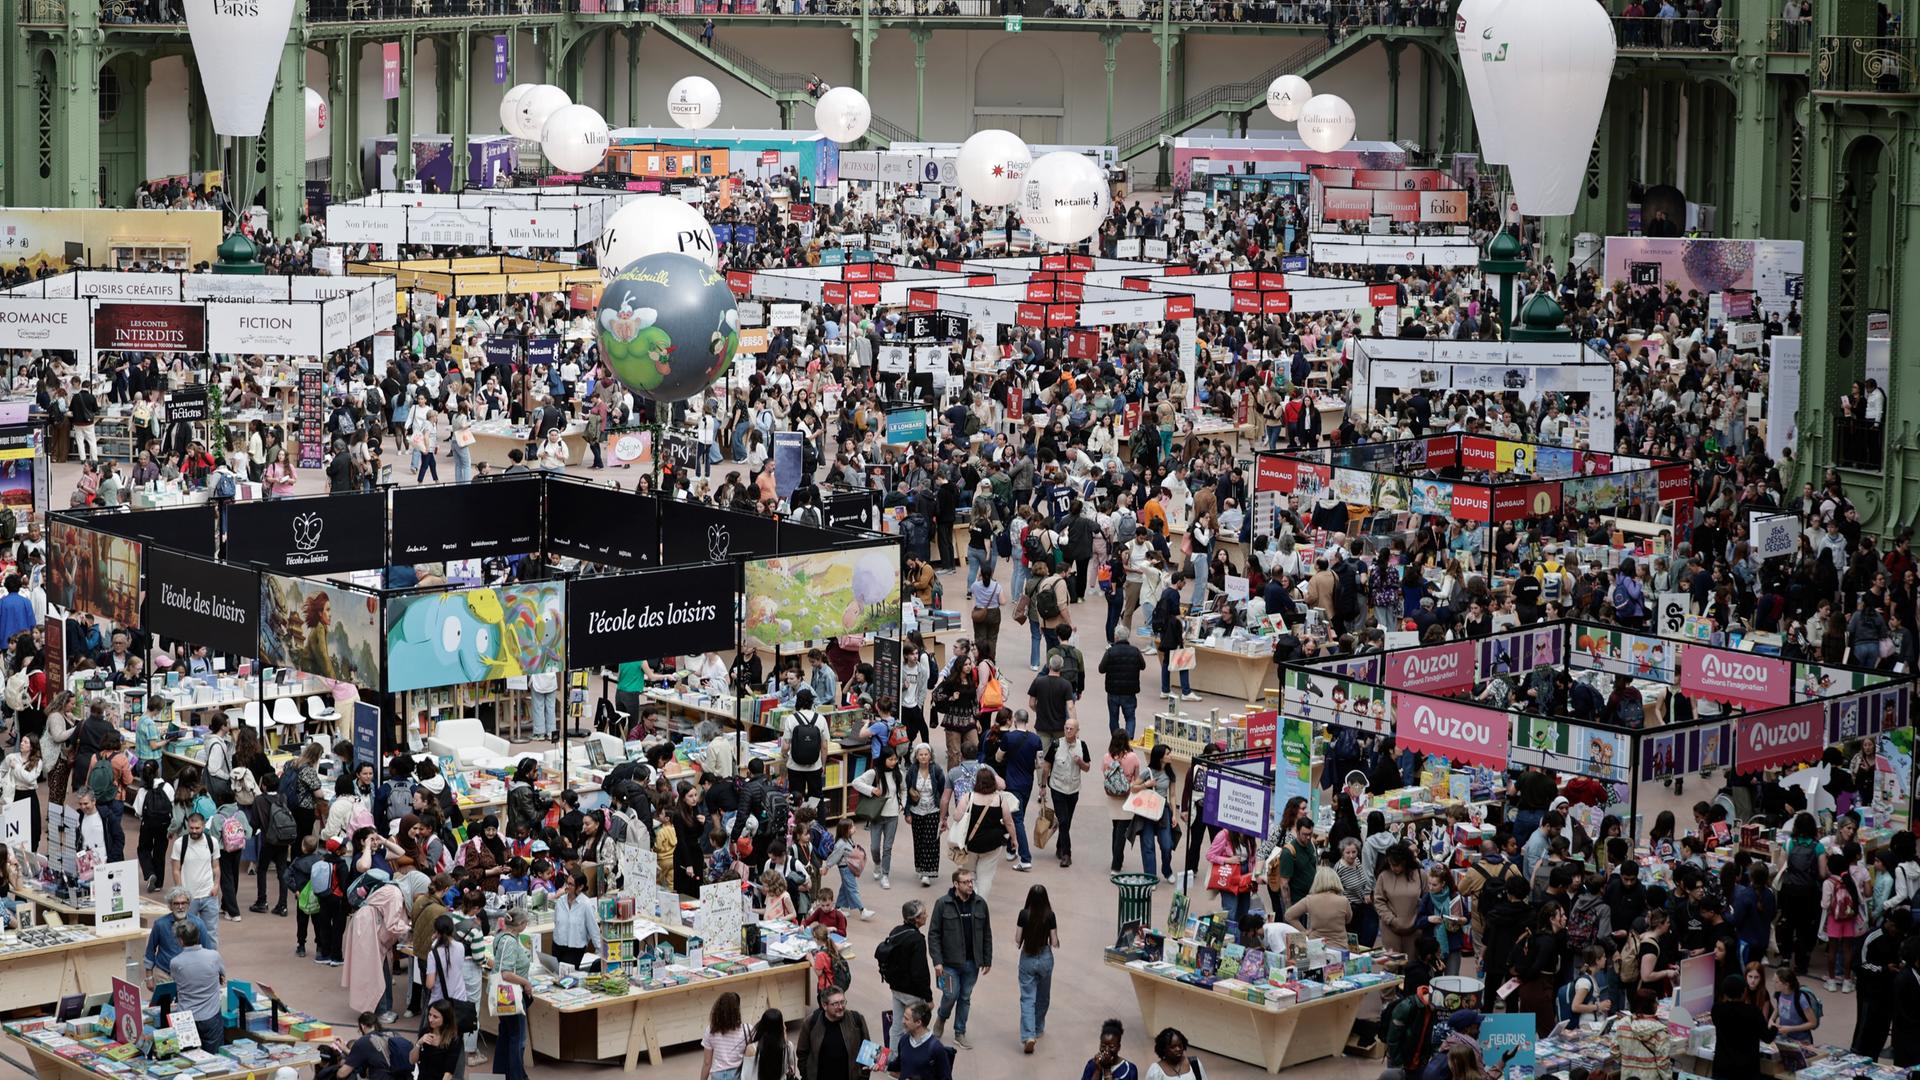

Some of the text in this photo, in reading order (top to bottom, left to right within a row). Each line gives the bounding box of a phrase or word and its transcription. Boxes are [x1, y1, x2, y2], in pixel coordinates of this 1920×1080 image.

[1054, 197, 1091, 208] Métailié
[1328, 199, 1369, 211] Gallimard
[1430, 199, 1457, 215] folio
[508, 228, 560, 239] Albin Michel
[84, 284, 123, 295] LOISIRS
[126, 282, 174, 296] CRÉATIFS
[0, 311, 68, 325] ROMANCE
[142, 320, 168, 328] CONTES
[239, 317, 292, 329] FICTION
[115, 329, 184, 342] INTERDITS
[172, 408, 202, 421] fictions
[898, 421, 924, 430] LOMBARD
[1428, 448, 1454, 457] DARGAUD
[1463, 447, 1495, 459] DUPUIS
[1260, 469, 1293, 480] DARGAUD
[1659, 477, 1688, 489] DUPUIS
[1056, 496, 1070, 512] 10
[1453, 496, 1488, 509] DUPUIS
[1496, 499, 1525, 509] DARGAUD
[161, 582, 246, 625] l'école des loisirs
[588, 599, 716, 635] l'école des loisirs
[1229, 805, 1244, 814] GRAND
[118, 985, 136, 1005] abc
[1489, 1033, 1526, 1046] FLEURUS
